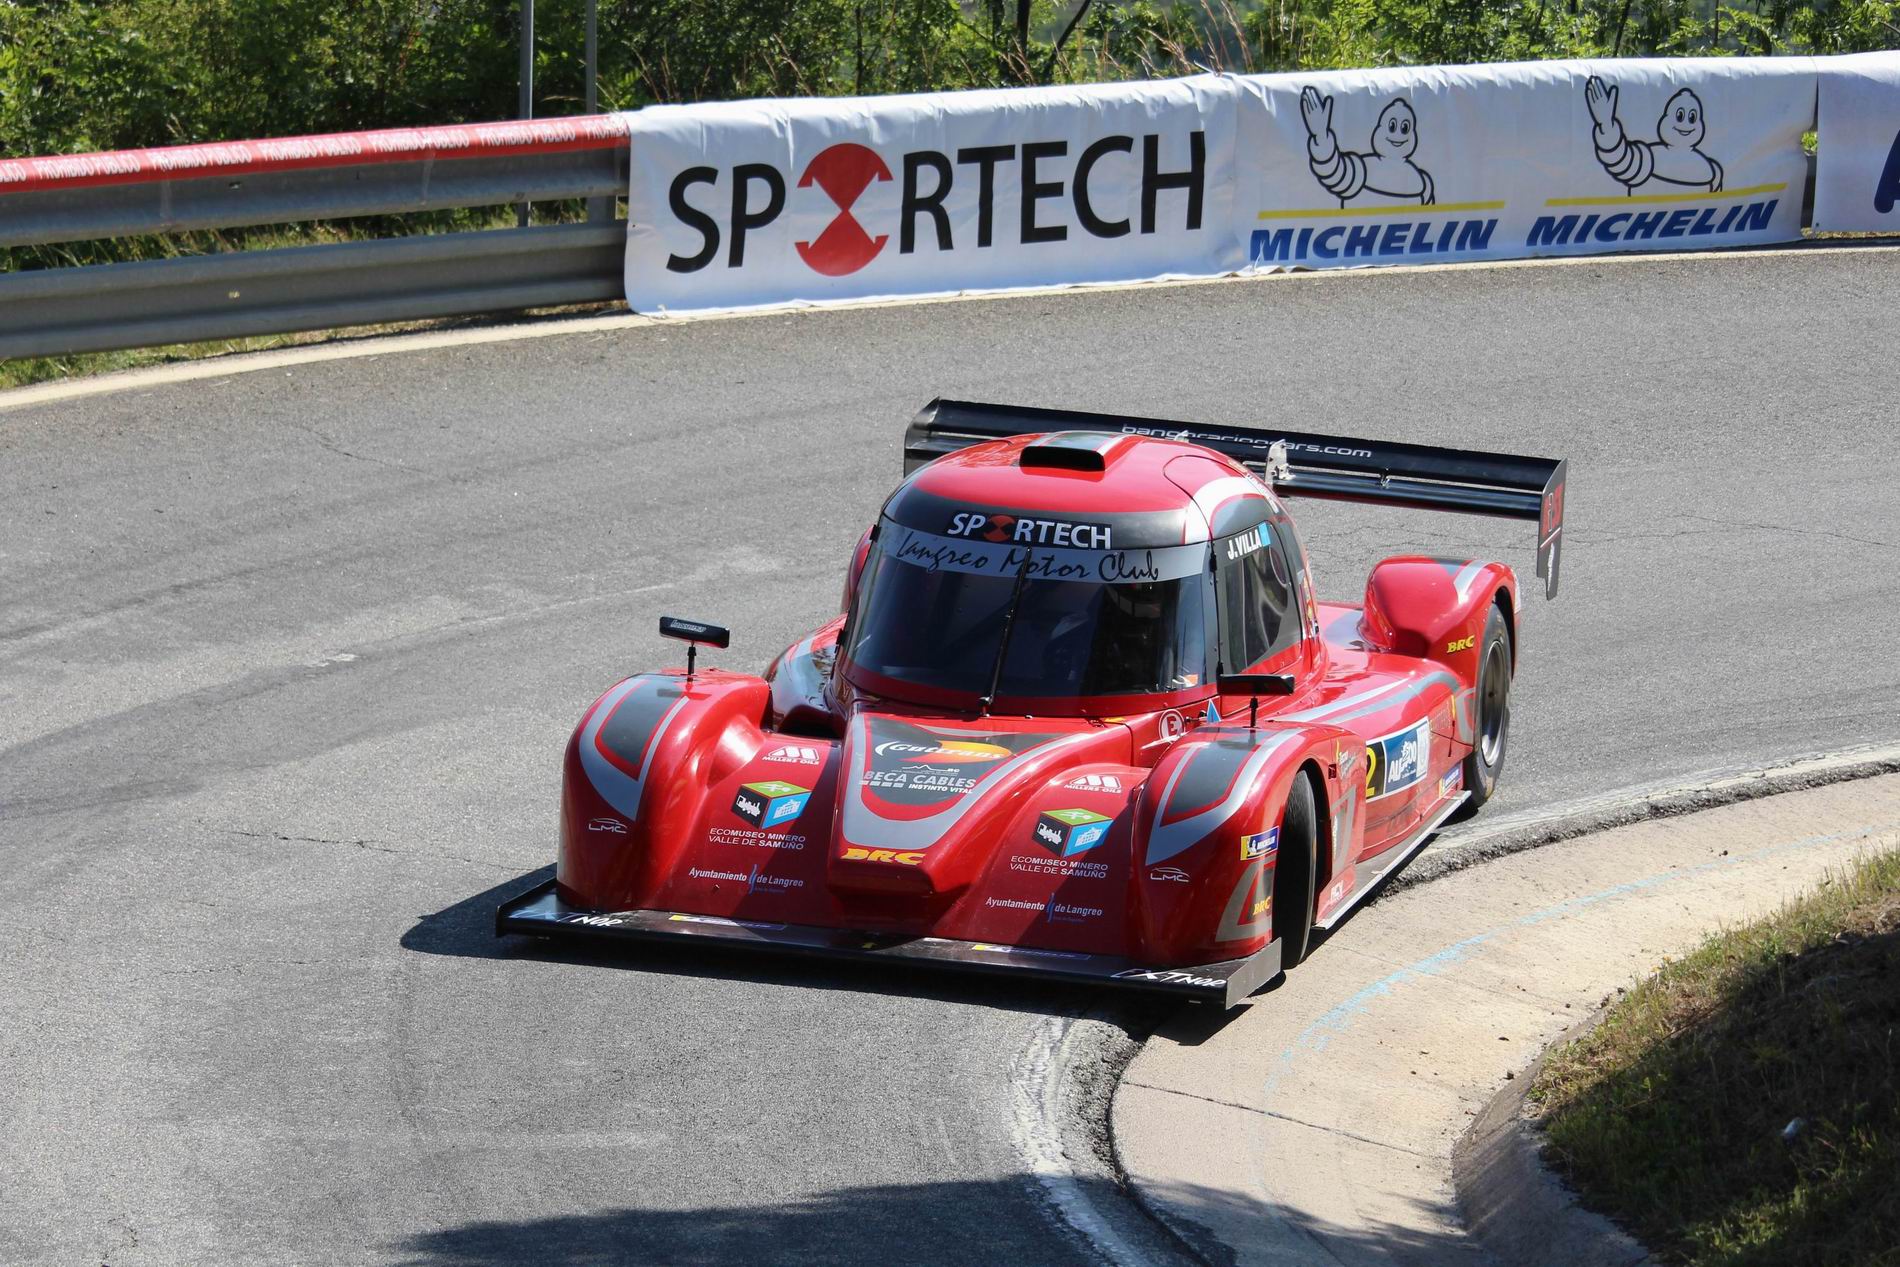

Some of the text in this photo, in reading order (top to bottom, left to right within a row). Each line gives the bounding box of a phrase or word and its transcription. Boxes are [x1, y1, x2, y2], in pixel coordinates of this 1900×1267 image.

[667, 130, 1206, 276] SPORTECH
[1526, 199, 1778, 246] MICHELIN
[1250, 218, 1498, 261] MICHELIN
[947, 512, 1111, 549] SPORTECH
[1227, 529, 1263, 560] J.VILLA
[896, 531, 1159, 581] Langreo Motor Club
[1447, 635, 1475, 653] BRC
[863, 771, 907, 783] BECA
[913, 775, 977, 788] CABLES
[908, 783, 949, 792] INSTINTO
[588, 823, 627, 834] LMC
[710, 828, 806, 843] ECOMUSEO MINERO
[709, 835, 804, 850] VALLE DE SAMUÑO
[841, 848, 926, 865] BRC
[1011, 856, 1108, 870] ECOMUSEO MINERO
[689, 867, 804, 888] Ayuntamiento de Langreo
[1010, 863, 1106, 879] VALLE DE SAMUÑO
[1150, 873, 1189, 882] LMC
[986, 896, 1103, 917] Ayuntamiento de Langreo
[1253, 896, 1271, 915] BRC
